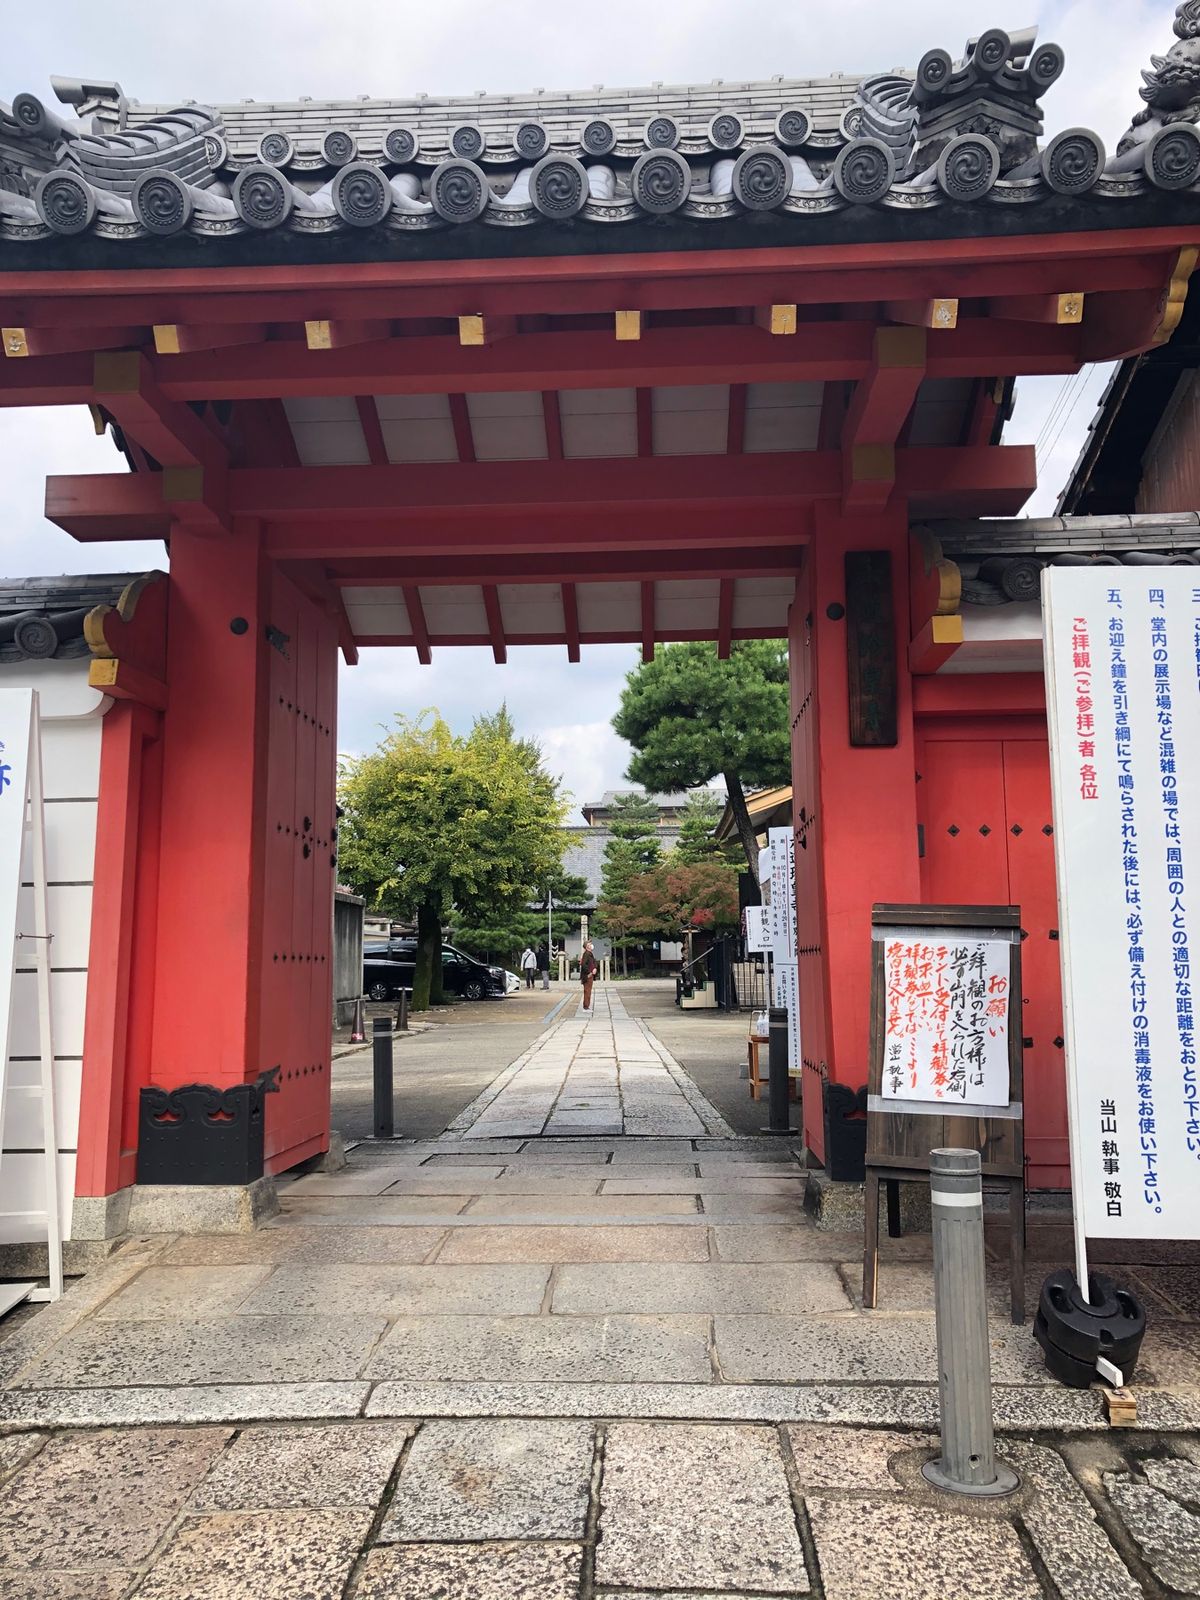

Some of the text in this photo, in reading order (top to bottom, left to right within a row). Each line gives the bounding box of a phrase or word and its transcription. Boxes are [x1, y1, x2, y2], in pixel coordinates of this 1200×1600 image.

[1079, 763, 1098, 800] 各位
[760, 909, 770, 942] 拝観入口
[1107, 588, 1162, 1214] 五、お迎え鐘を引き綱にて鳴らされた後には、必ず備え付けの消毒液をお使い下さい。
[984, 975, 1007, 1038] お願い
[1100, 1098, 1122, 1217] 当山 執事 敬白
